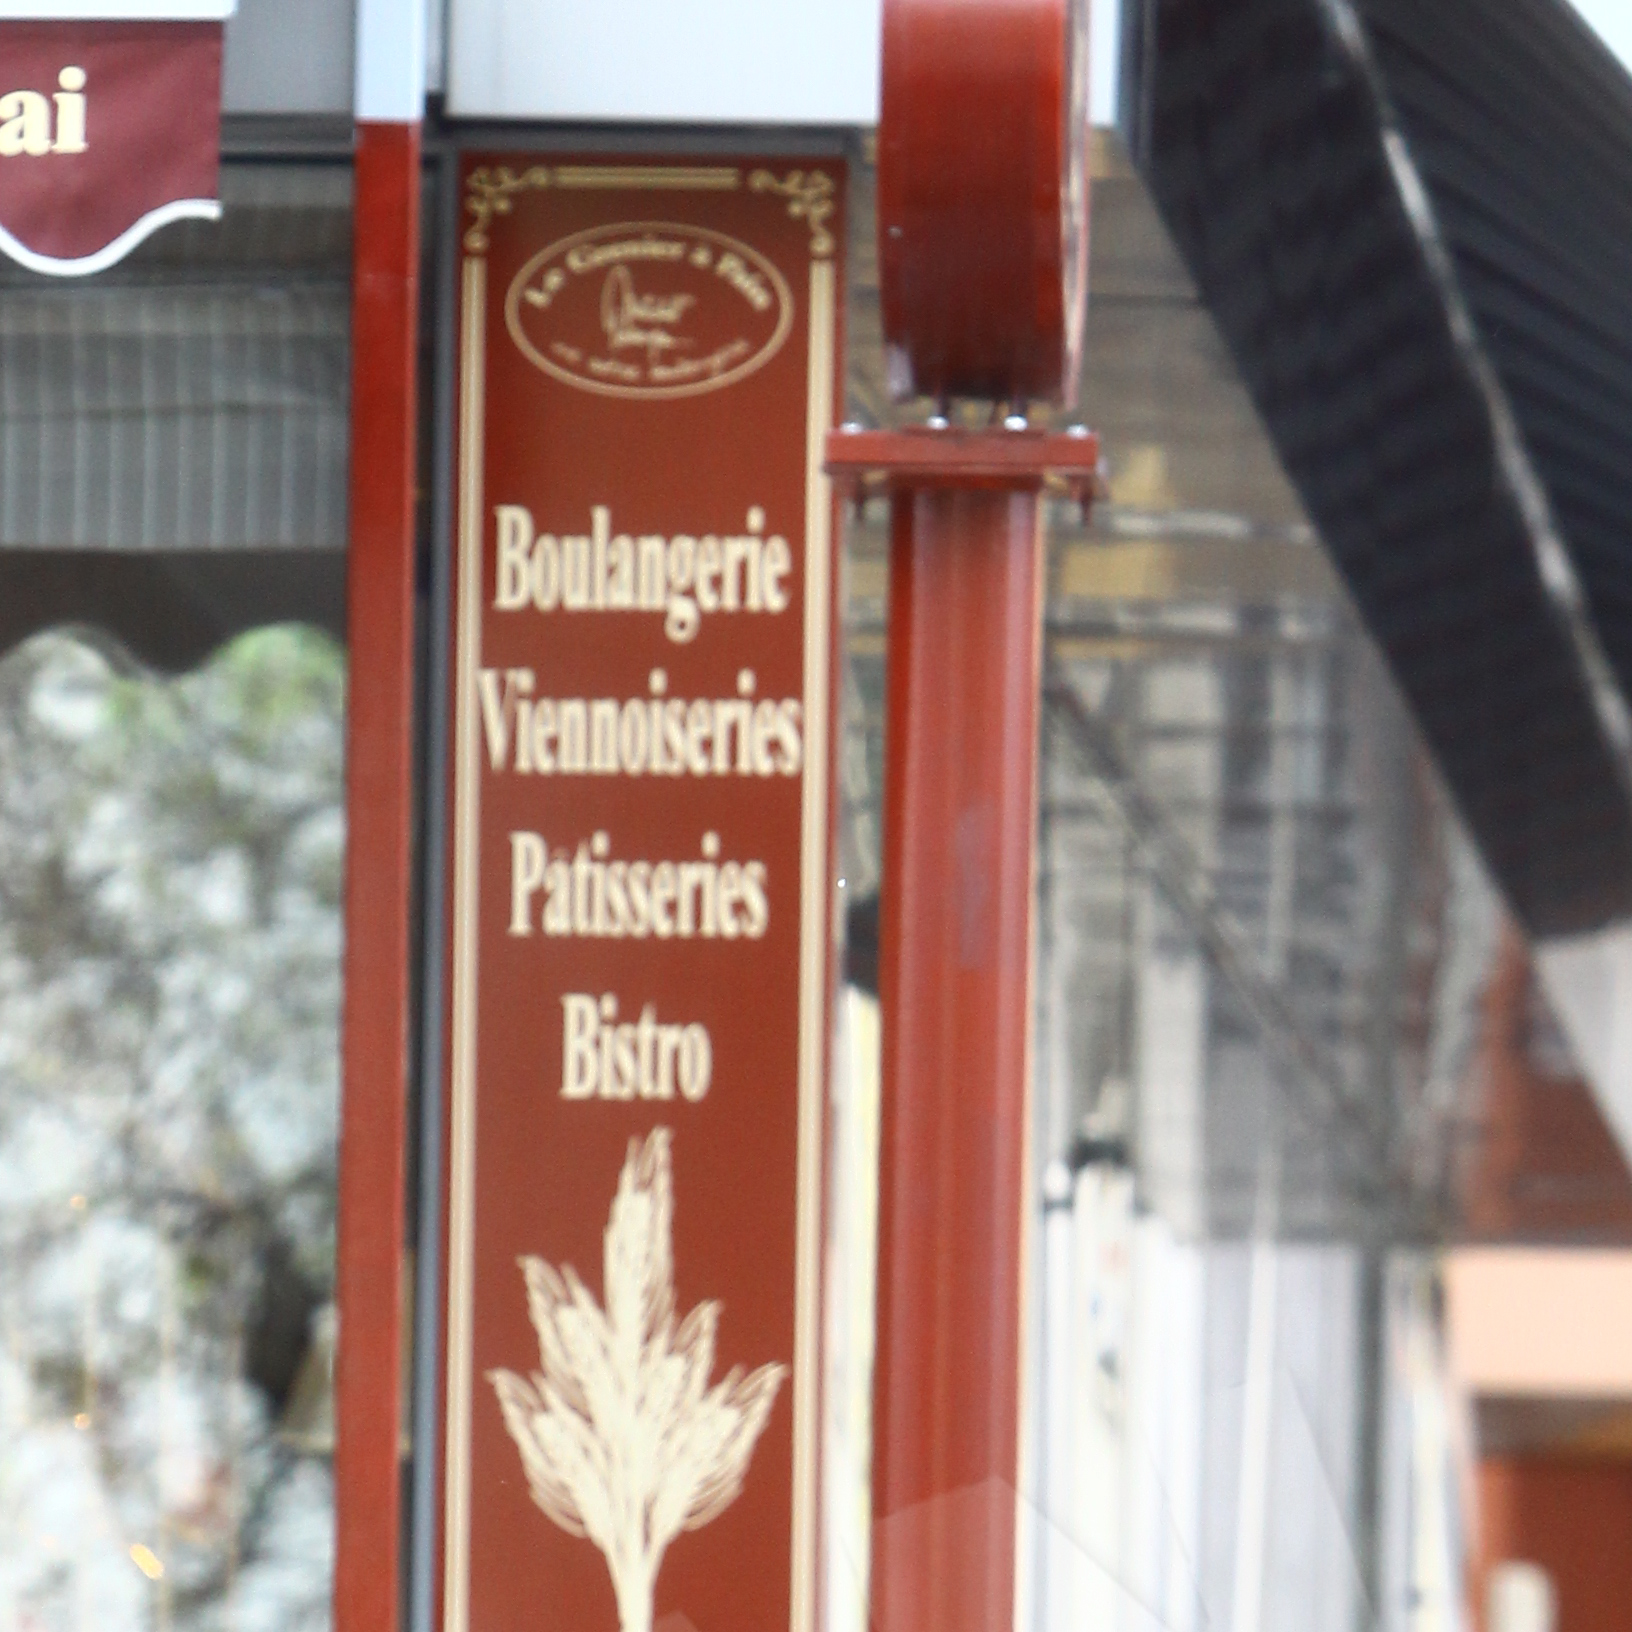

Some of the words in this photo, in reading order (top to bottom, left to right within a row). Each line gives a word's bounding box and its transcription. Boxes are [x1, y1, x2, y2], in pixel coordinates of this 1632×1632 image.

[492, 504, 792, 644] Boulangerie
[476, 668, 803, 777] Viennoiseries
[559, 993, 713, 1103] Bistro
